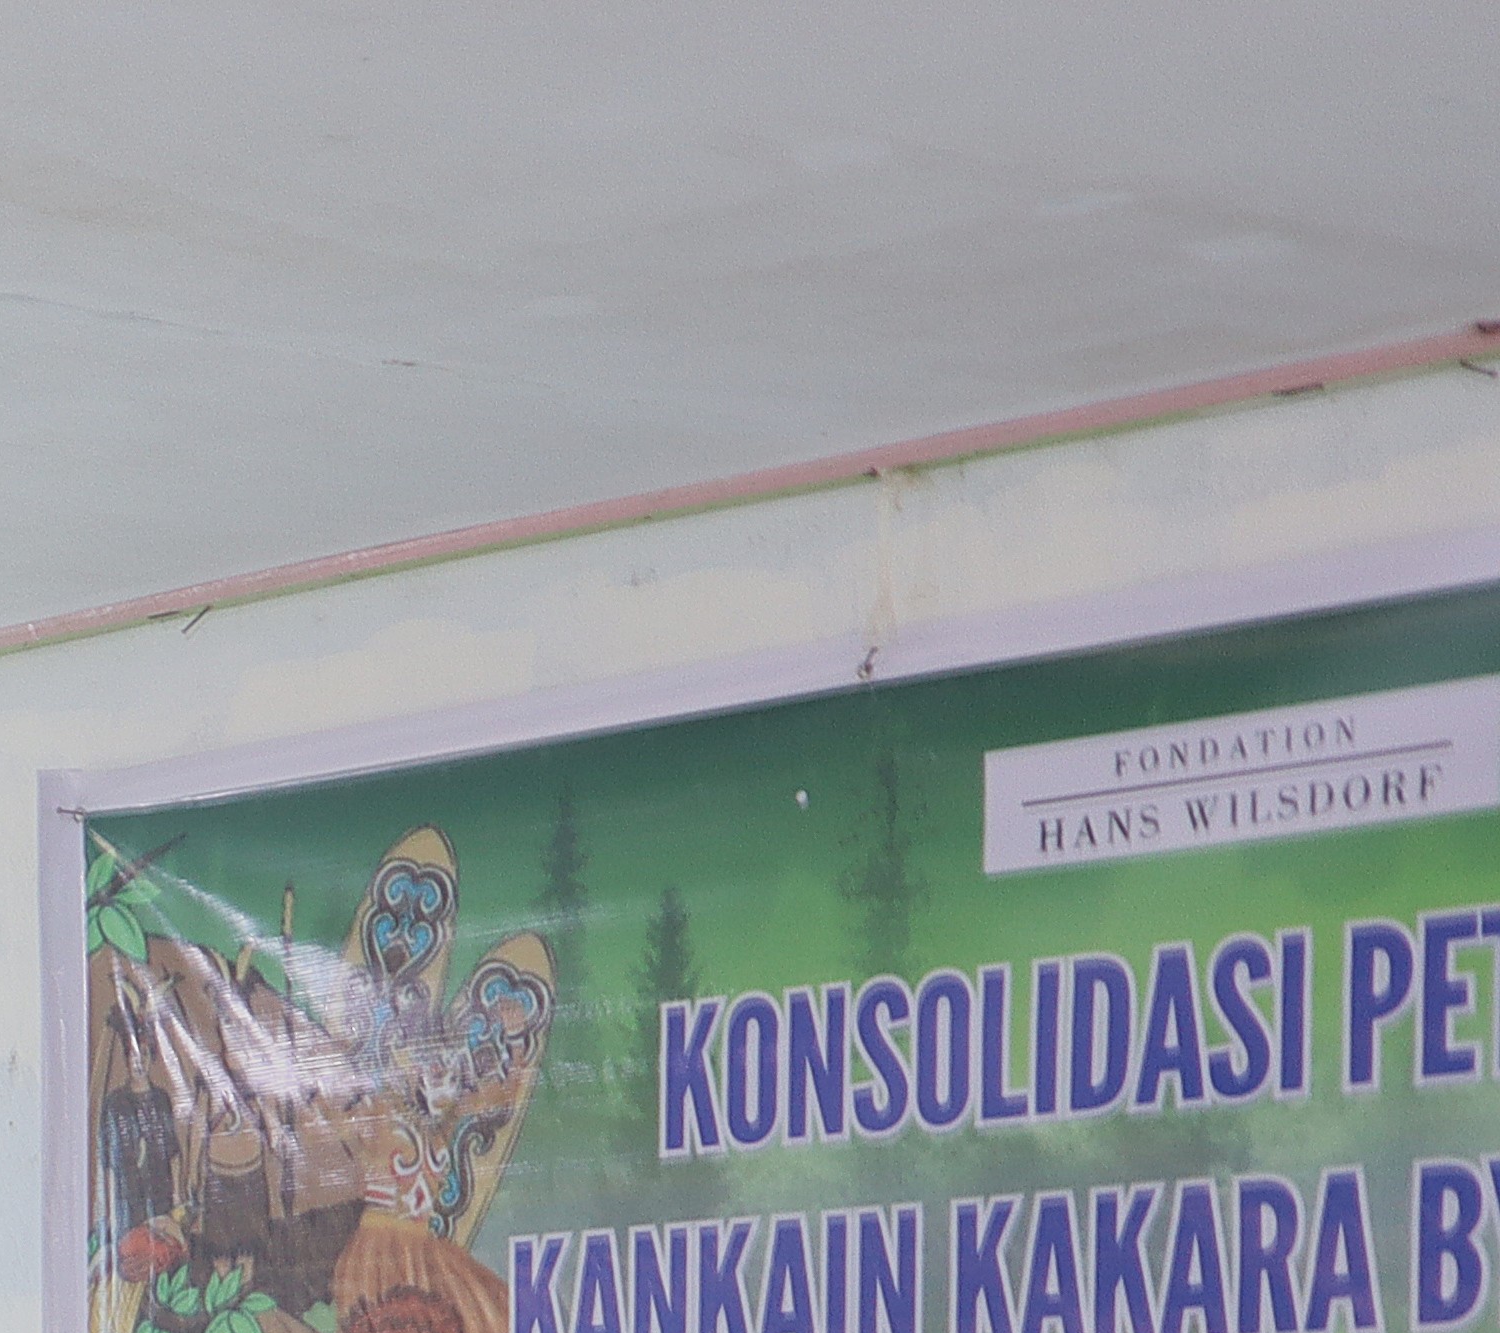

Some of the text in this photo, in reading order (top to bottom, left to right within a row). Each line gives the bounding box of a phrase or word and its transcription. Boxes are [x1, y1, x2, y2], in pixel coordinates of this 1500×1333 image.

[1113, 716, 1358, 779] FONDATION
[1039, 762, 1444, 853] HANS WILSDORF
[660, 928, 1311, 1158] KONSOLIDASI
